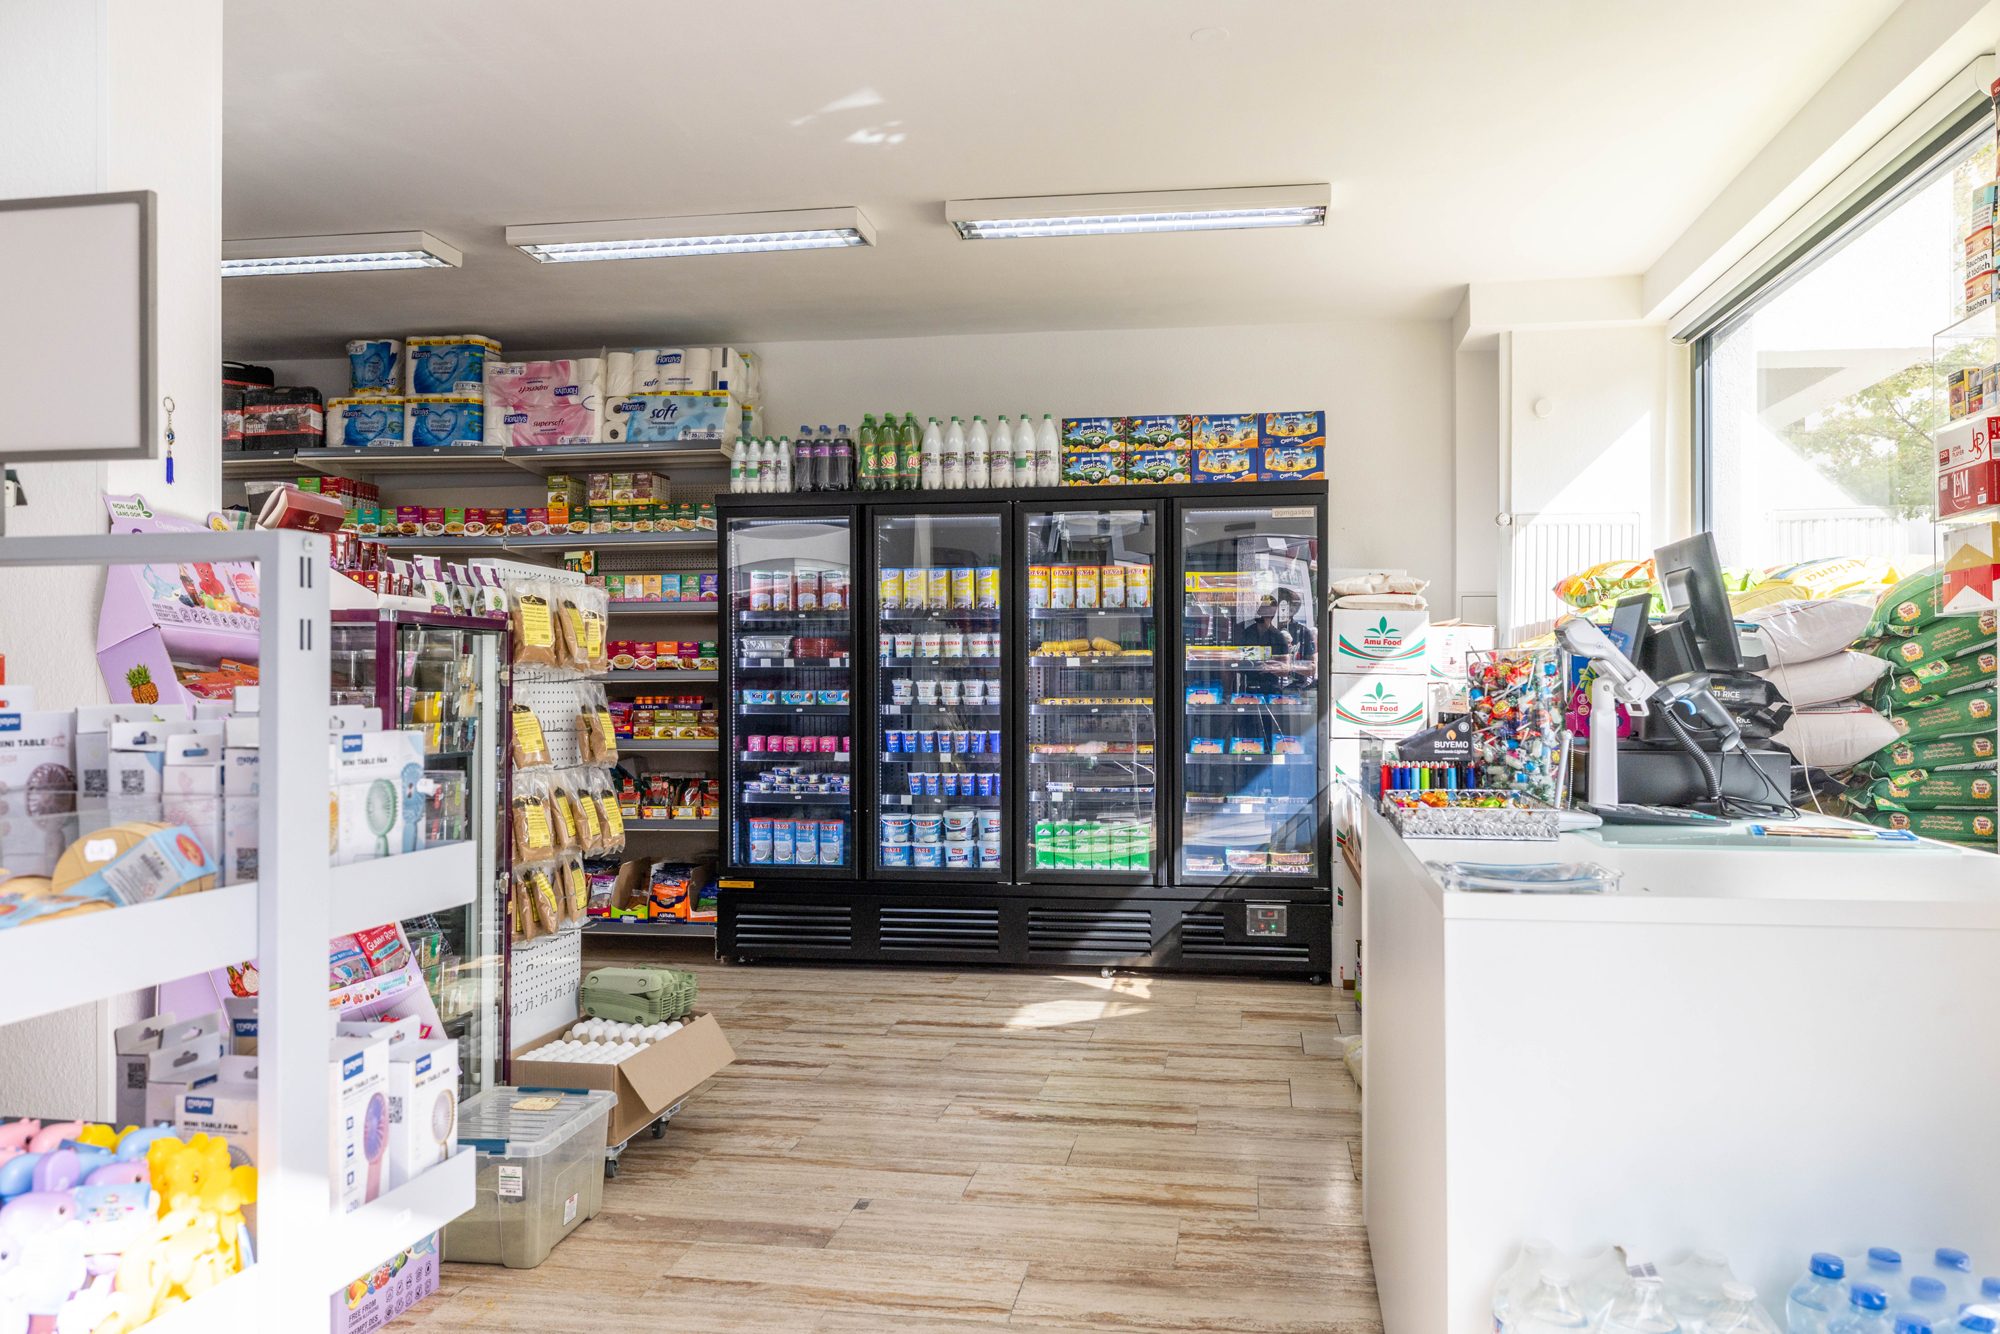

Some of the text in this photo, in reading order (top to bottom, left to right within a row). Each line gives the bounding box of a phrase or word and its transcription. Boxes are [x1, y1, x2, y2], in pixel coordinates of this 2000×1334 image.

[643, 378, 659, 387] soft
[650, 404, 678, 420] soft
[504, 414, 527, 424] Floralys
[533, 419, 565, 428] supersoft
[1080, 427, 1107, 436] Capri-Sun
[1145, 425, 1173, 434] Capri-Sun
[1080, 462, 1107, 471] Capri-Sun
[1144, 460, 1172, 469] Capri-Sun
[1383, 638, 1402, 646] Food
[0, 739, 46, 747] INI TABLE
[349, 1299, 377, 1322] FREE FROM
[369, 1314, 379, 1326] DES
